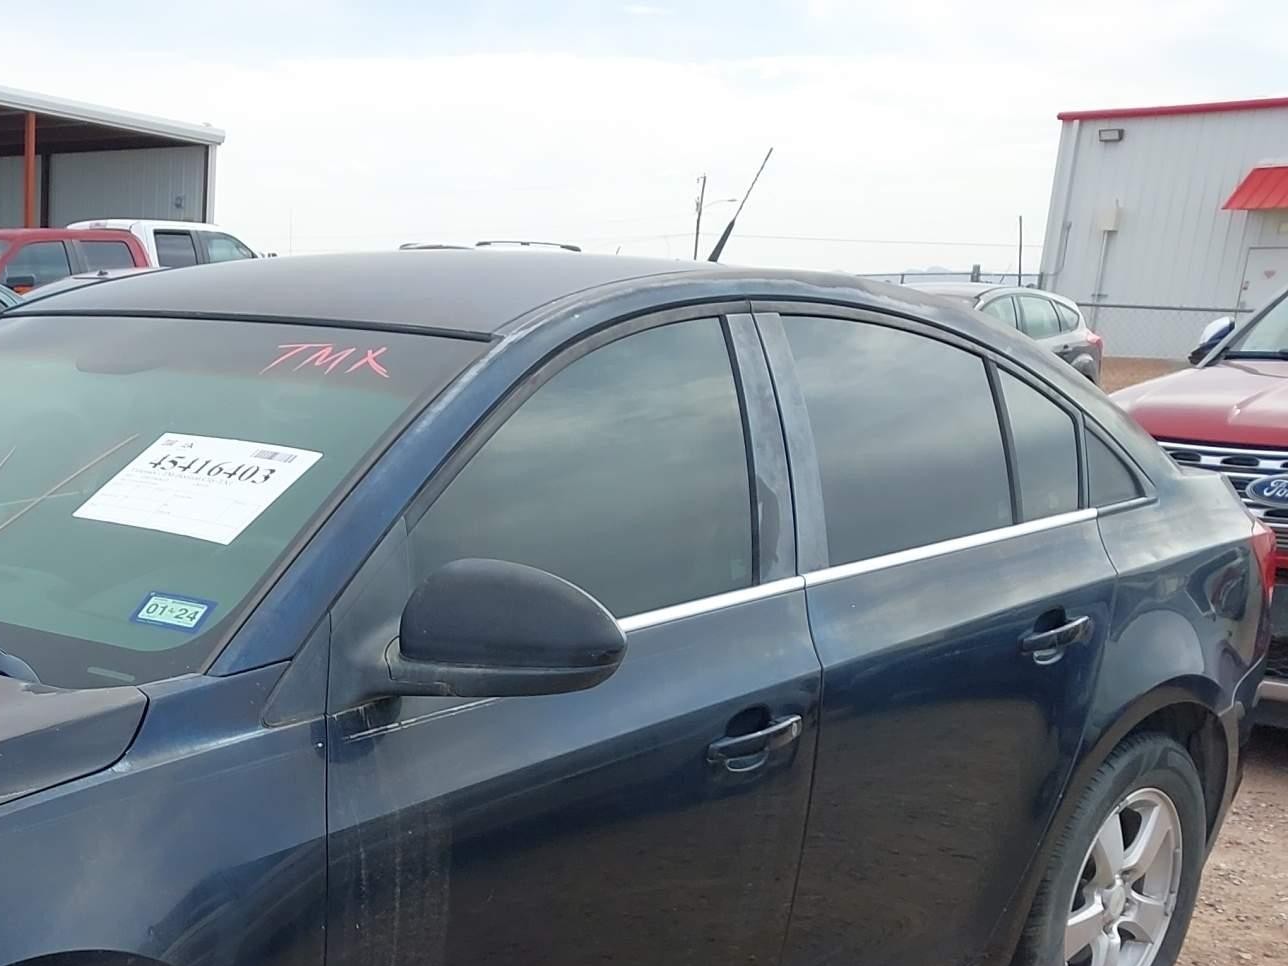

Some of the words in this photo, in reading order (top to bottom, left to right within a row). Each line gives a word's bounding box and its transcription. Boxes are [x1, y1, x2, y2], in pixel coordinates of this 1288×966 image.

[259, 343, 390, 378] TMX
[149, 453, 277, 485] 45416403
[1263, 479, 1288, 497] Fo
